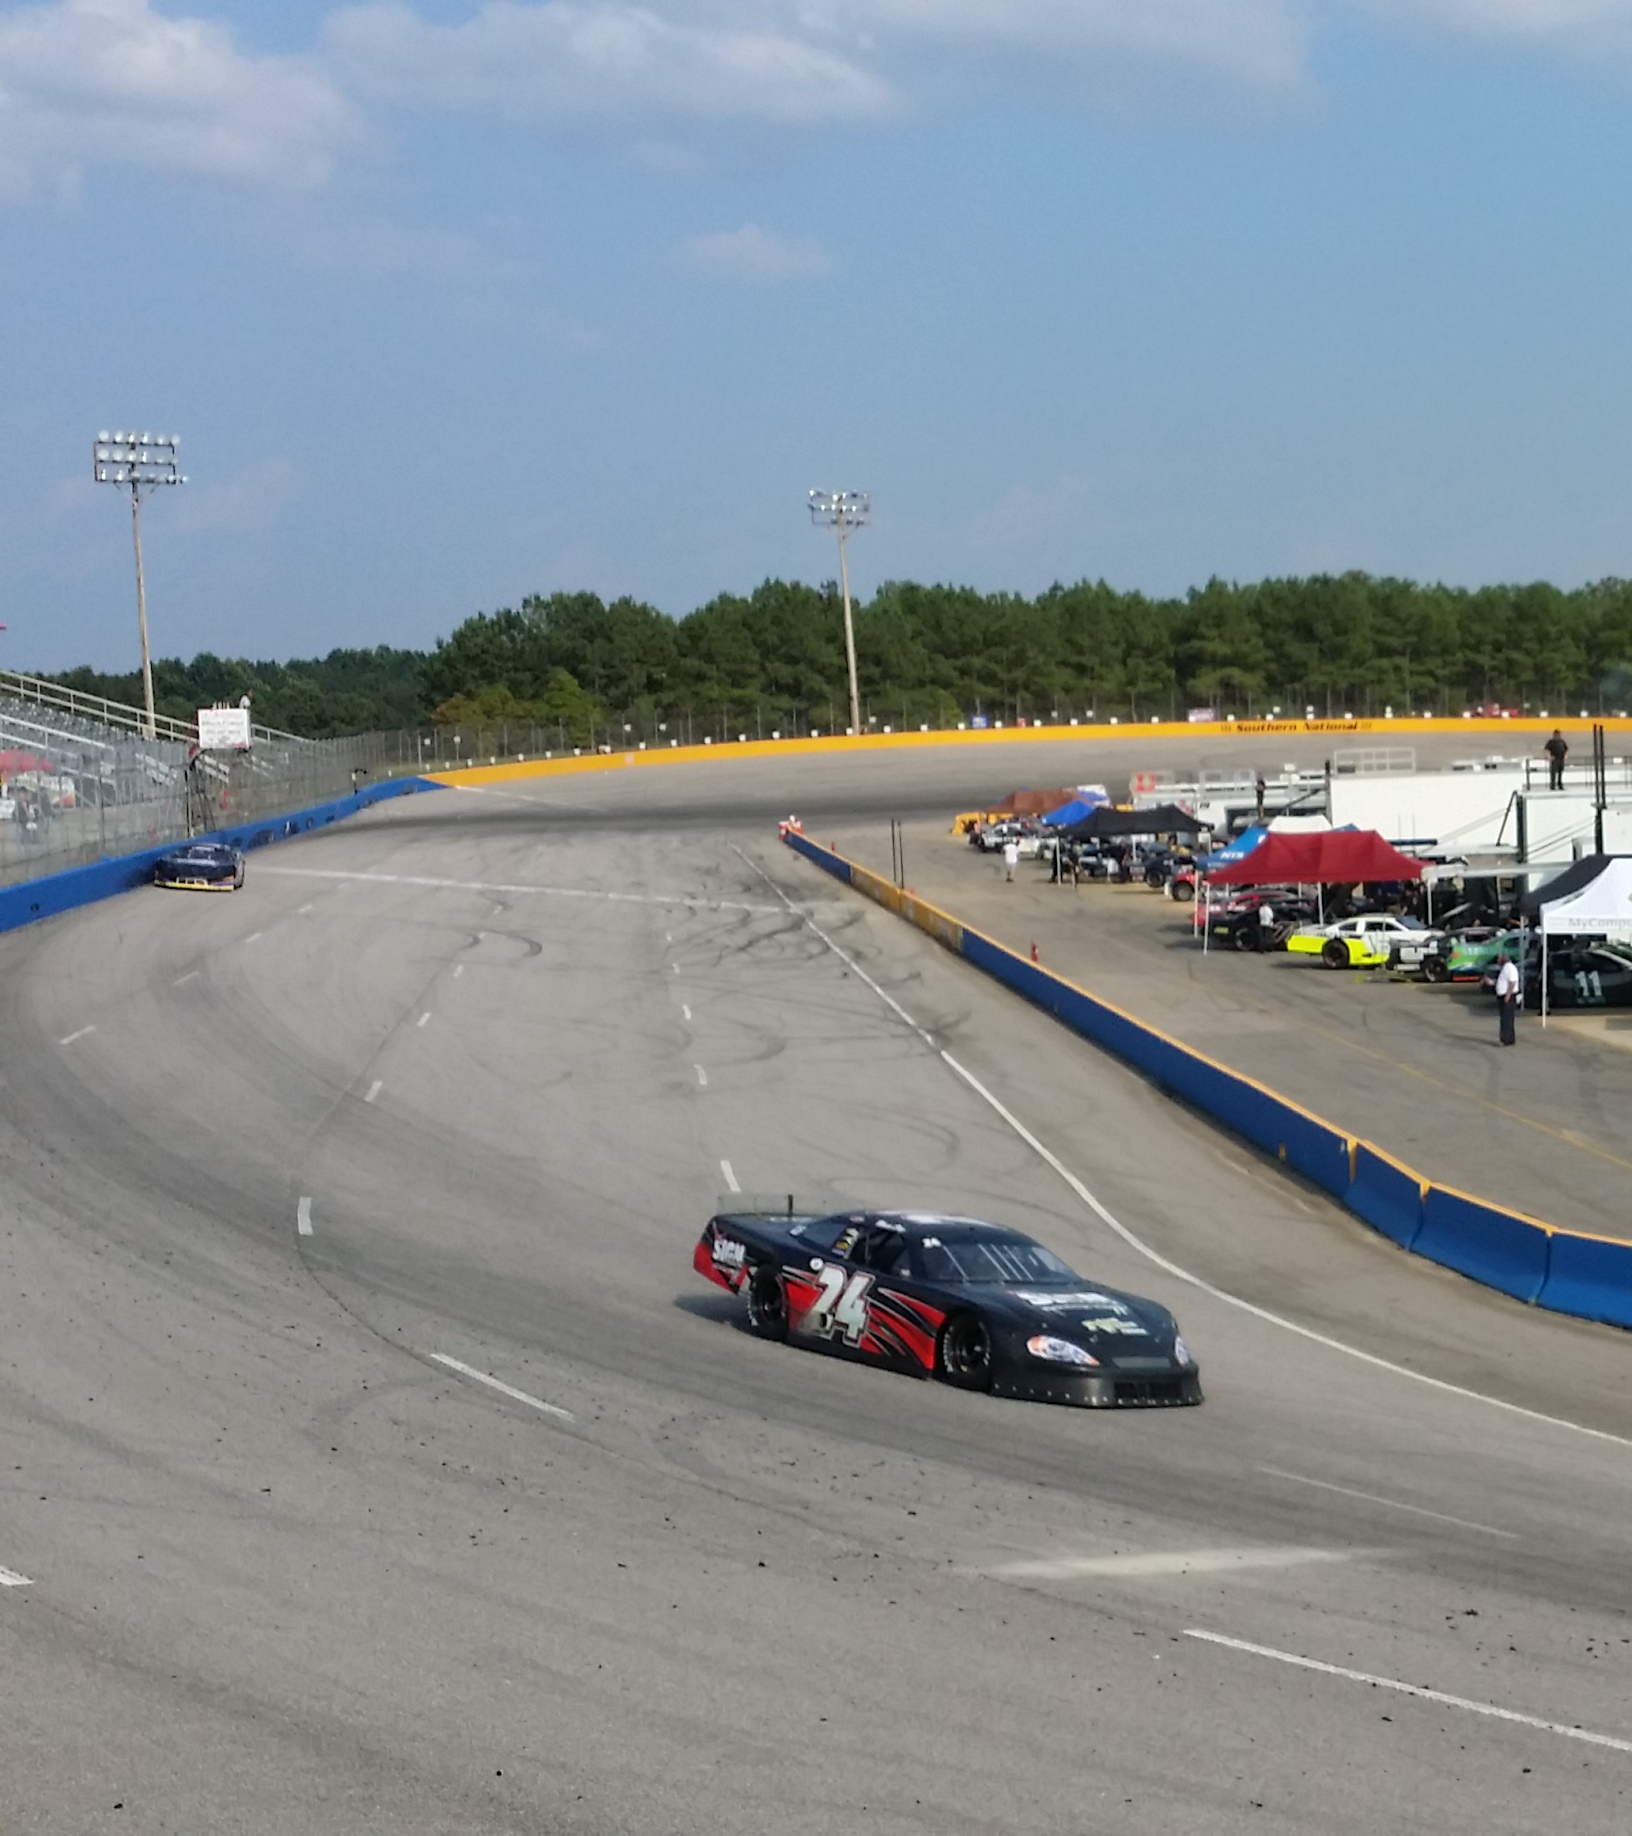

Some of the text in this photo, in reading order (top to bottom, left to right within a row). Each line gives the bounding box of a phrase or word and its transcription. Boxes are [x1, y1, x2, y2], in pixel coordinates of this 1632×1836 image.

[1236, 721, 1359, 733] Southern National
[1574, 970, 1603, 997] 11
